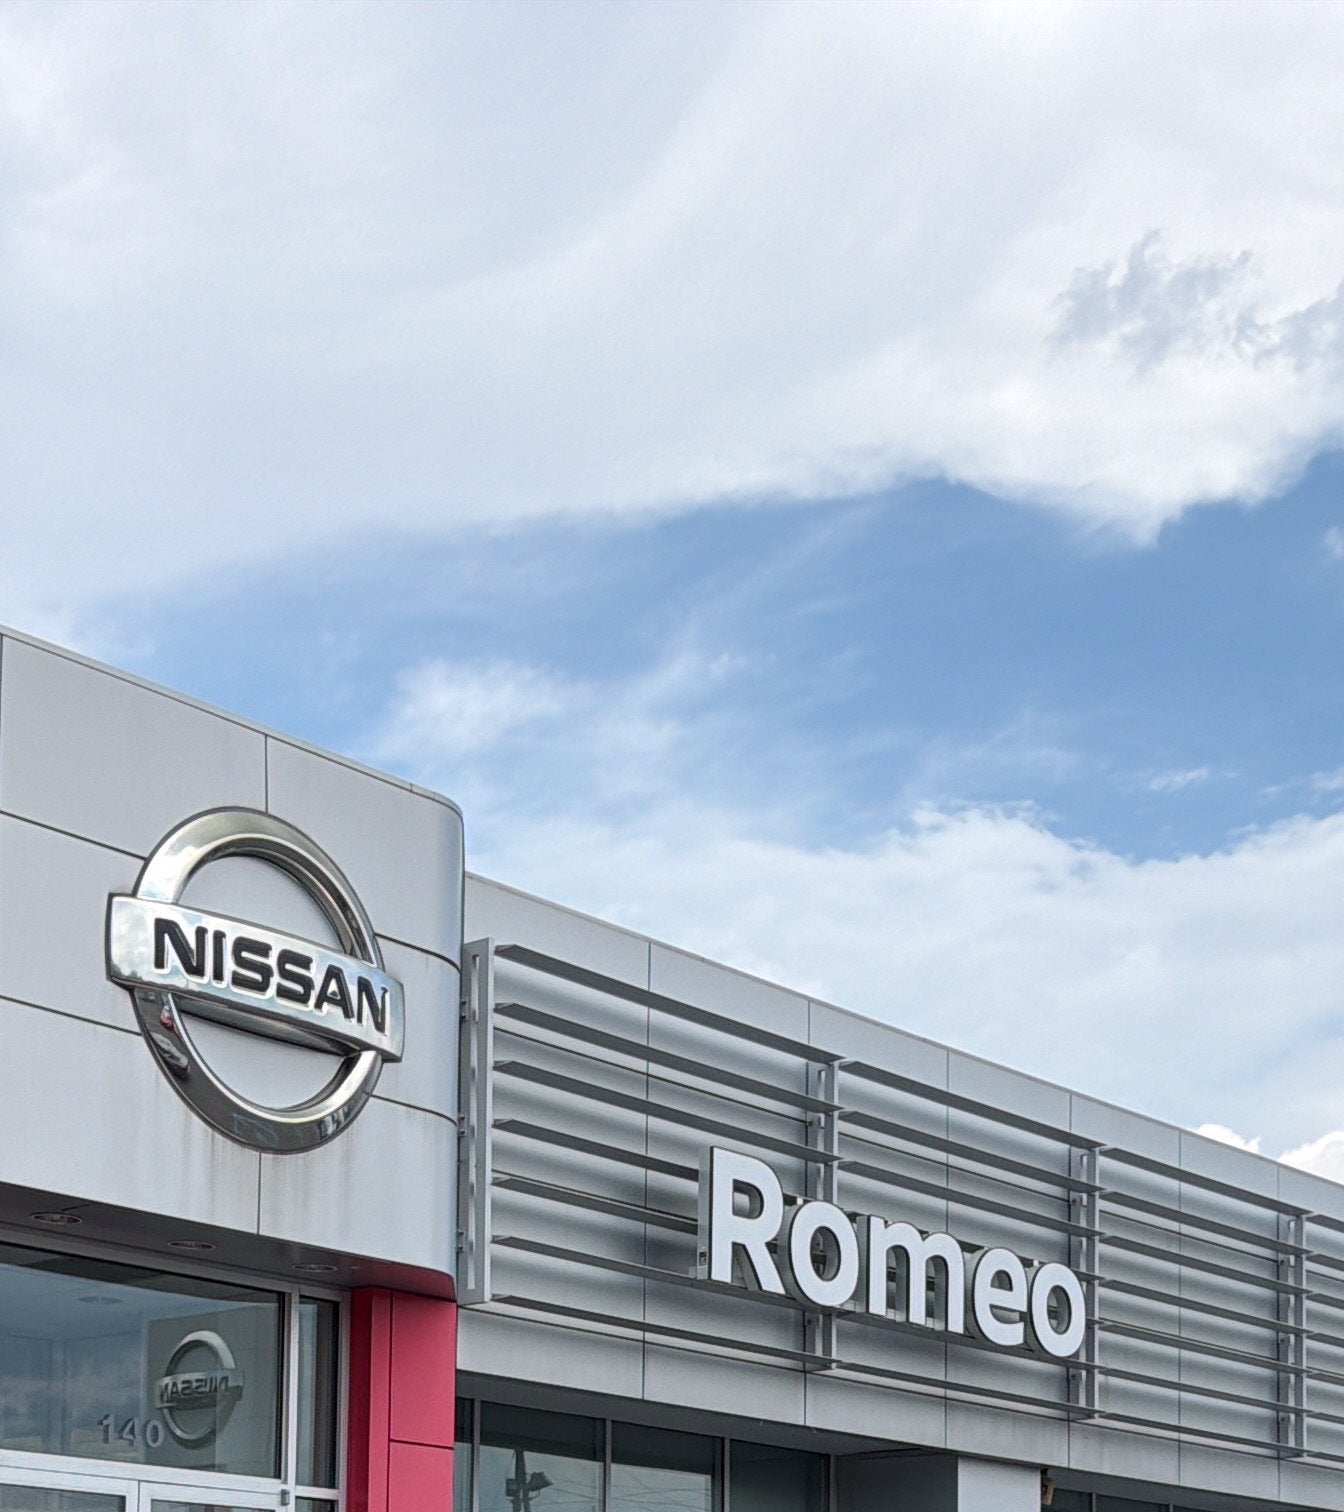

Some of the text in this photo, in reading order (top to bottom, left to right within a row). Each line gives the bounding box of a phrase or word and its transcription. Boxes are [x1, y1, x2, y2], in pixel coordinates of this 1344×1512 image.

[154, 917, 389, 1035] NISSAN
[706, 1145, 1086, 1358] Romeo
[97, 1413, 166, 1448] 140
